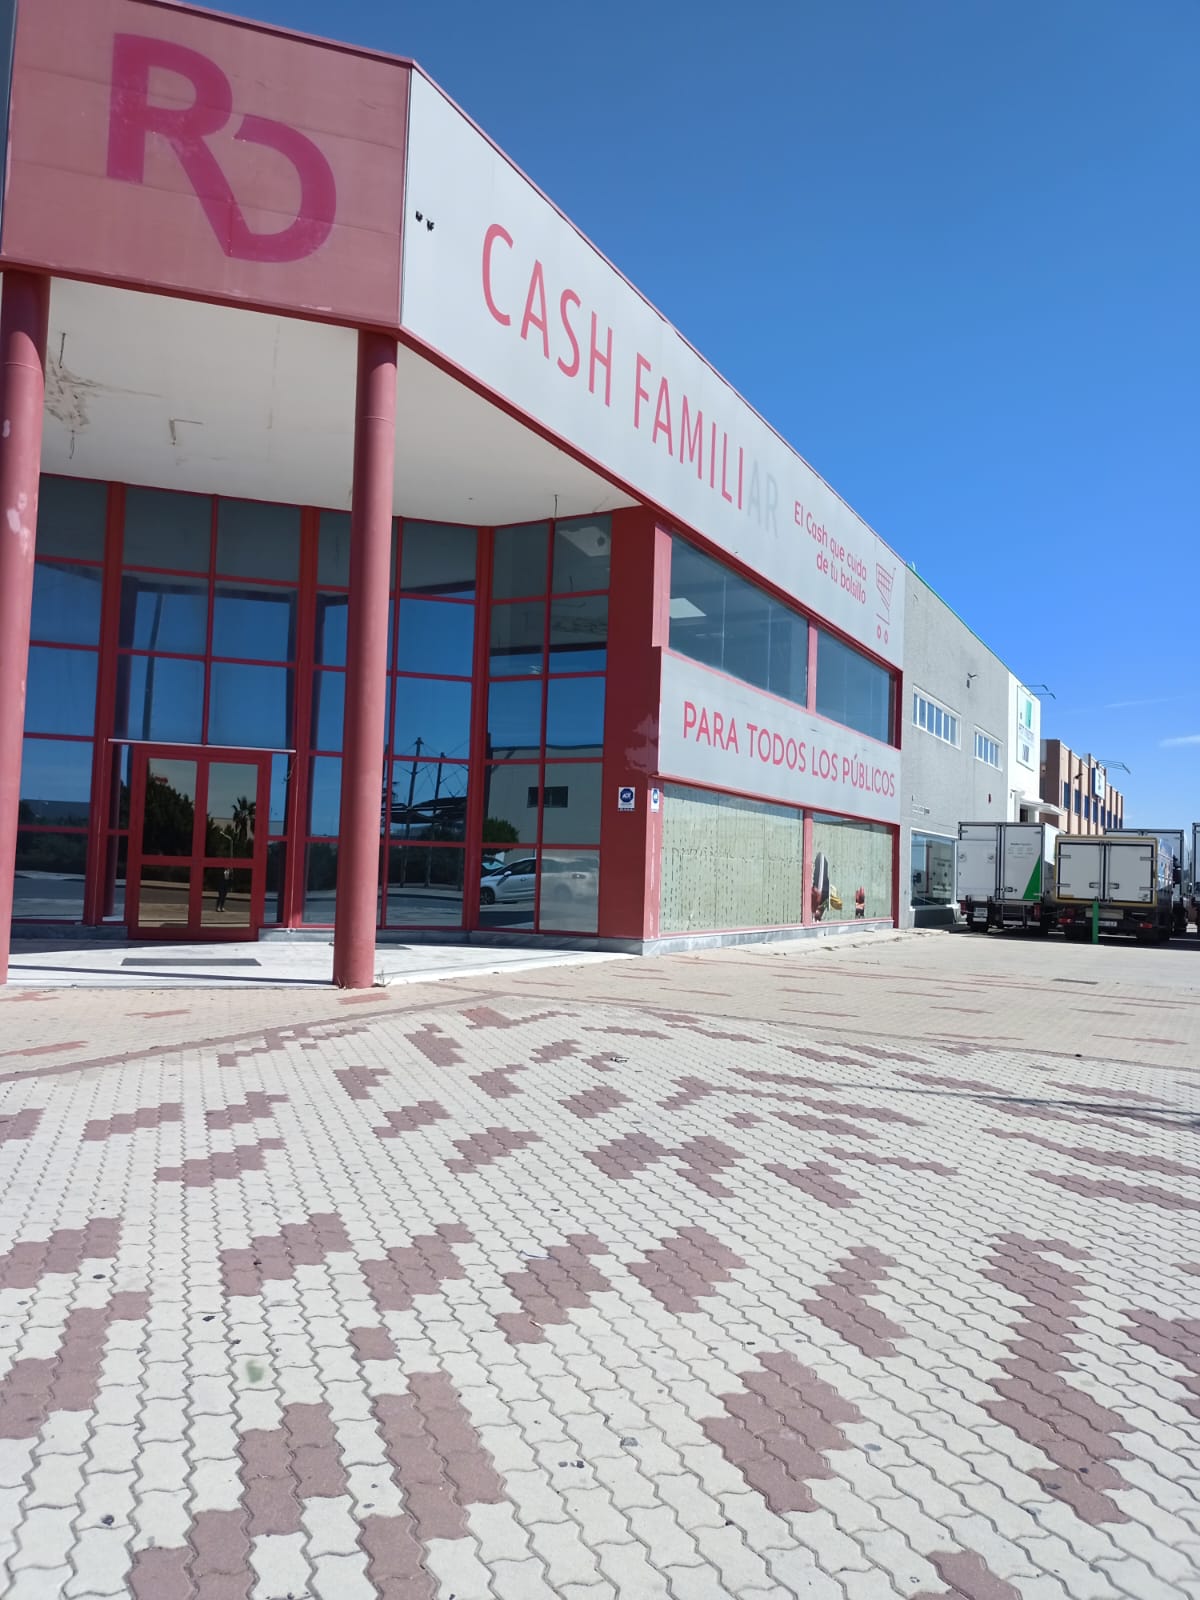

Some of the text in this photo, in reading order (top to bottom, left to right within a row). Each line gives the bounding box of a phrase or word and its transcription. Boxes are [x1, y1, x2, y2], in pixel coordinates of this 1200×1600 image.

[481, 223, 778, 539] CASH FAMILIAR
[794, 500, 867, 581] El Cash que cuida
[816, 550, 866, 605] de tu bolsillo
[683, 700, 895, 798] PARA TODOS LOS PÚBLICOS
